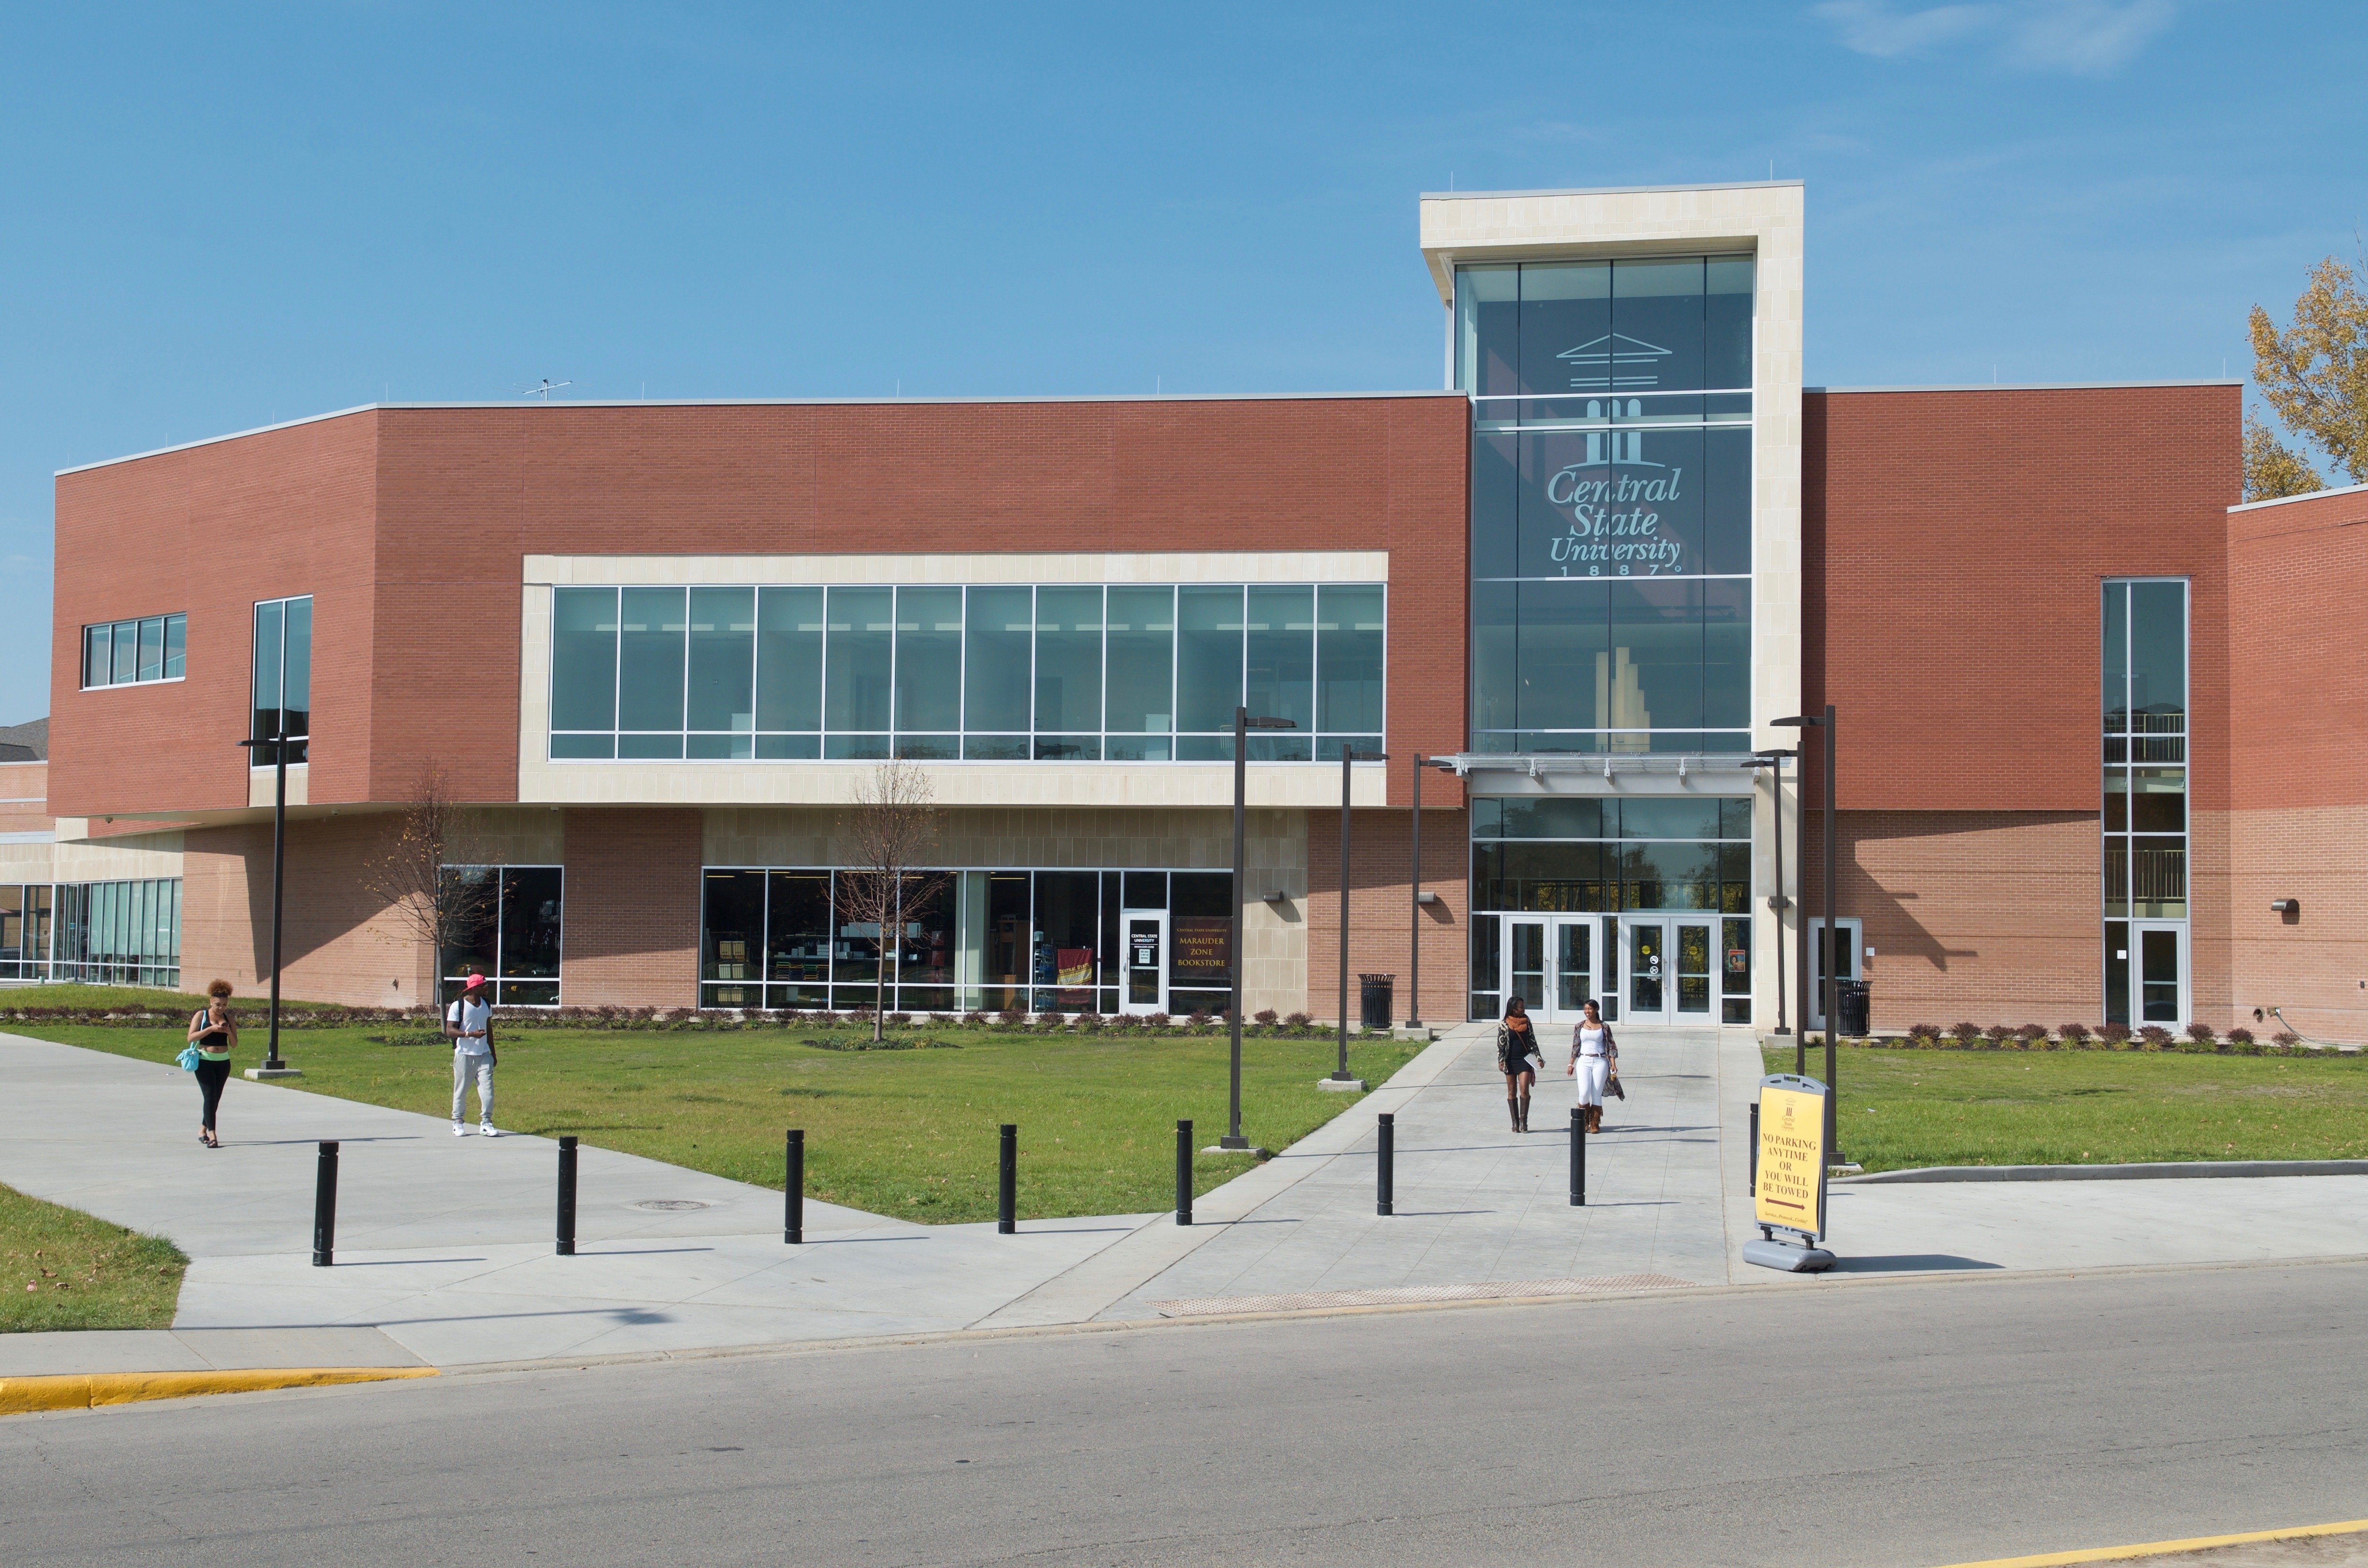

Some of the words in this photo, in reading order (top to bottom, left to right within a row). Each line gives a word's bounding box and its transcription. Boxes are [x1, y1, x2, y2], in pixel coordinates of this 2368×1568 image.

[1548, 467, 1681, 504] Central
[1569, 504, 1658, 537] State
[1551, 537, 1680, 568] University
[1763, 1133, 1774, 1143] NO
[1776, 1135, 1816, 1150] PARKING
[1767, 1147, 1808, 1162] ANYTIME
[1779, 1161, 1792, 1171] OR
[1765, 1170, 1782, 1181] YOU
[1784, 1174, 1808, 1187] WILL
[1764, 1182, 1774, 1192] BE
[1775, 1184, 1808, 1199] TOWED
